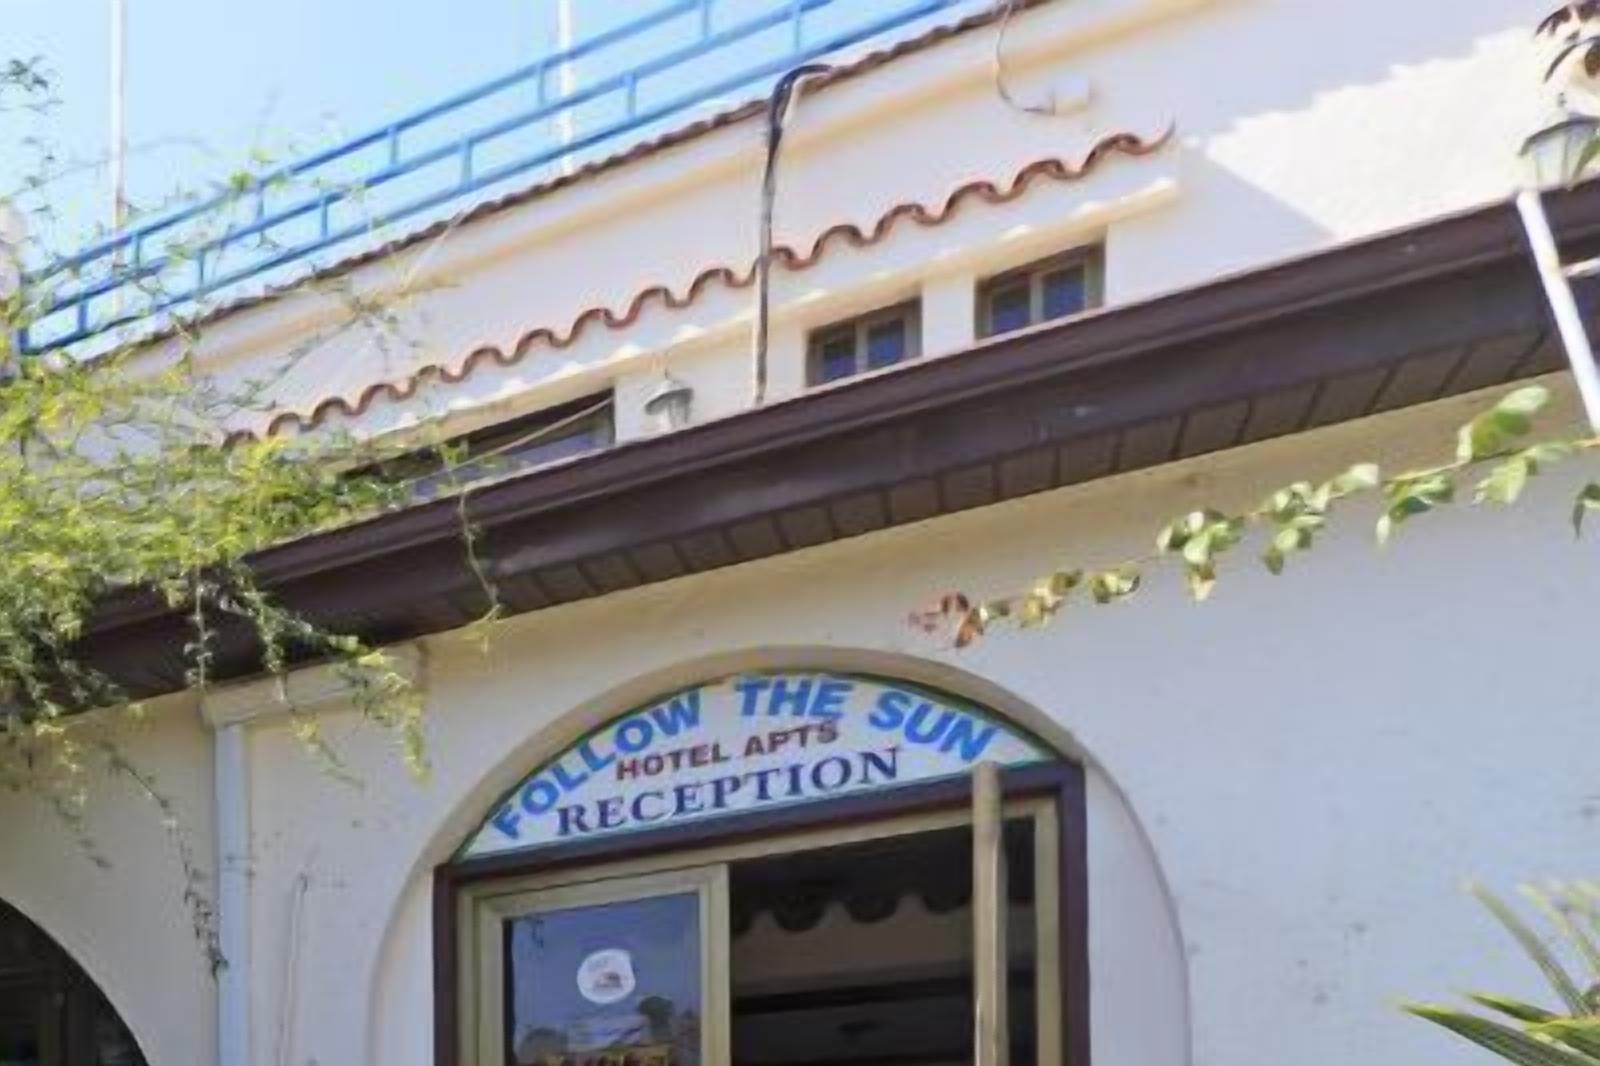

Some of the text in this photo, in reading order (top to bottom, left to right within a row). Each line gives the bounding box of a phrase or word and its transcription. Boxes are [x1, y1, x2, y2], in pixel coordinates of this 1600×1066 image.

[493, 680, 1000, 839] FOLLOW THE SUN
[555, 748, 898, 836] RECEPTION
[615, 719, 839, 781] HOTEL APTS
